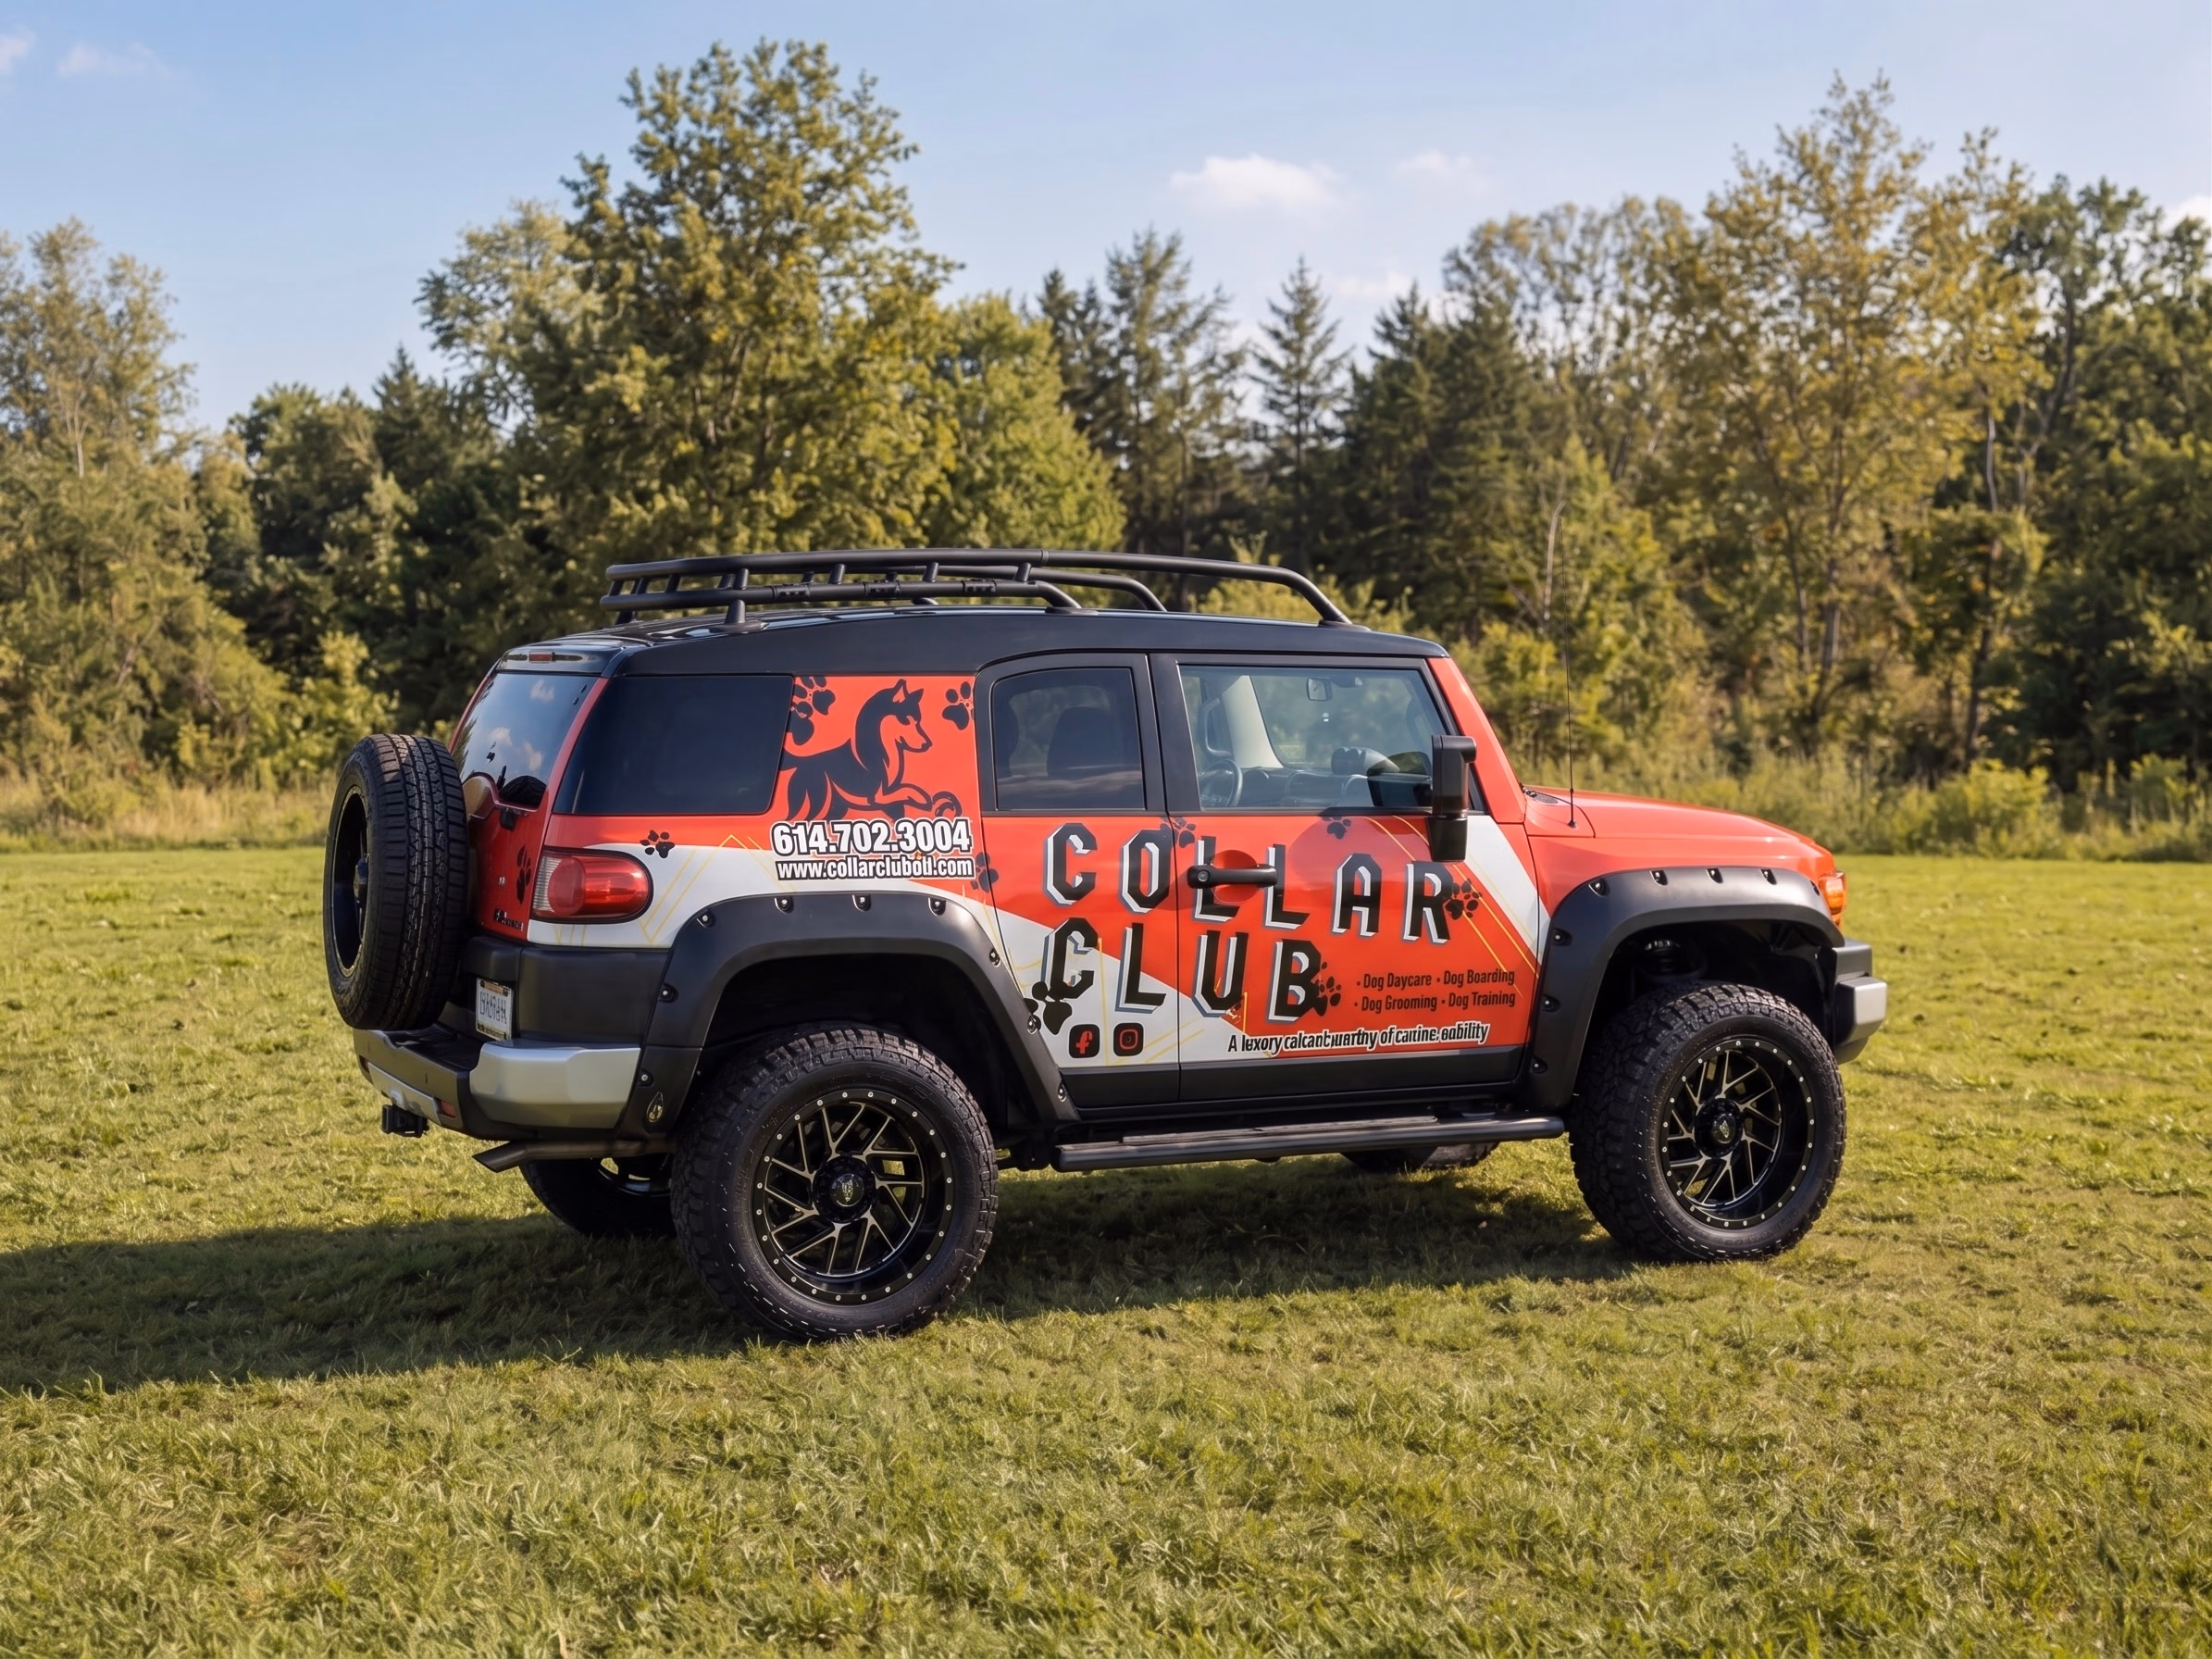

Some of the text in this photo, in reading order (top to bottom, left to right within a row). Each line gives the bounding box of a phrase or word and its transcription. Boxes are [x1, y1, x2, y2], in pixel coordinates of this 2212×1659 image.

[773, 819, 971, 856] 614.702.3004
[1043, 823, 1451, 943] COLLAR
[1040, 917, 1322, 1022] CLUB
[1363, 968, 1515, 991] Dog Daycare Dog Boarding
[1361, 991, 1516, 1014] Dog Grooming Dog Training
[1228, 1034, 1237, 1052] A
[1380, 1027, 1395, 1044] of
